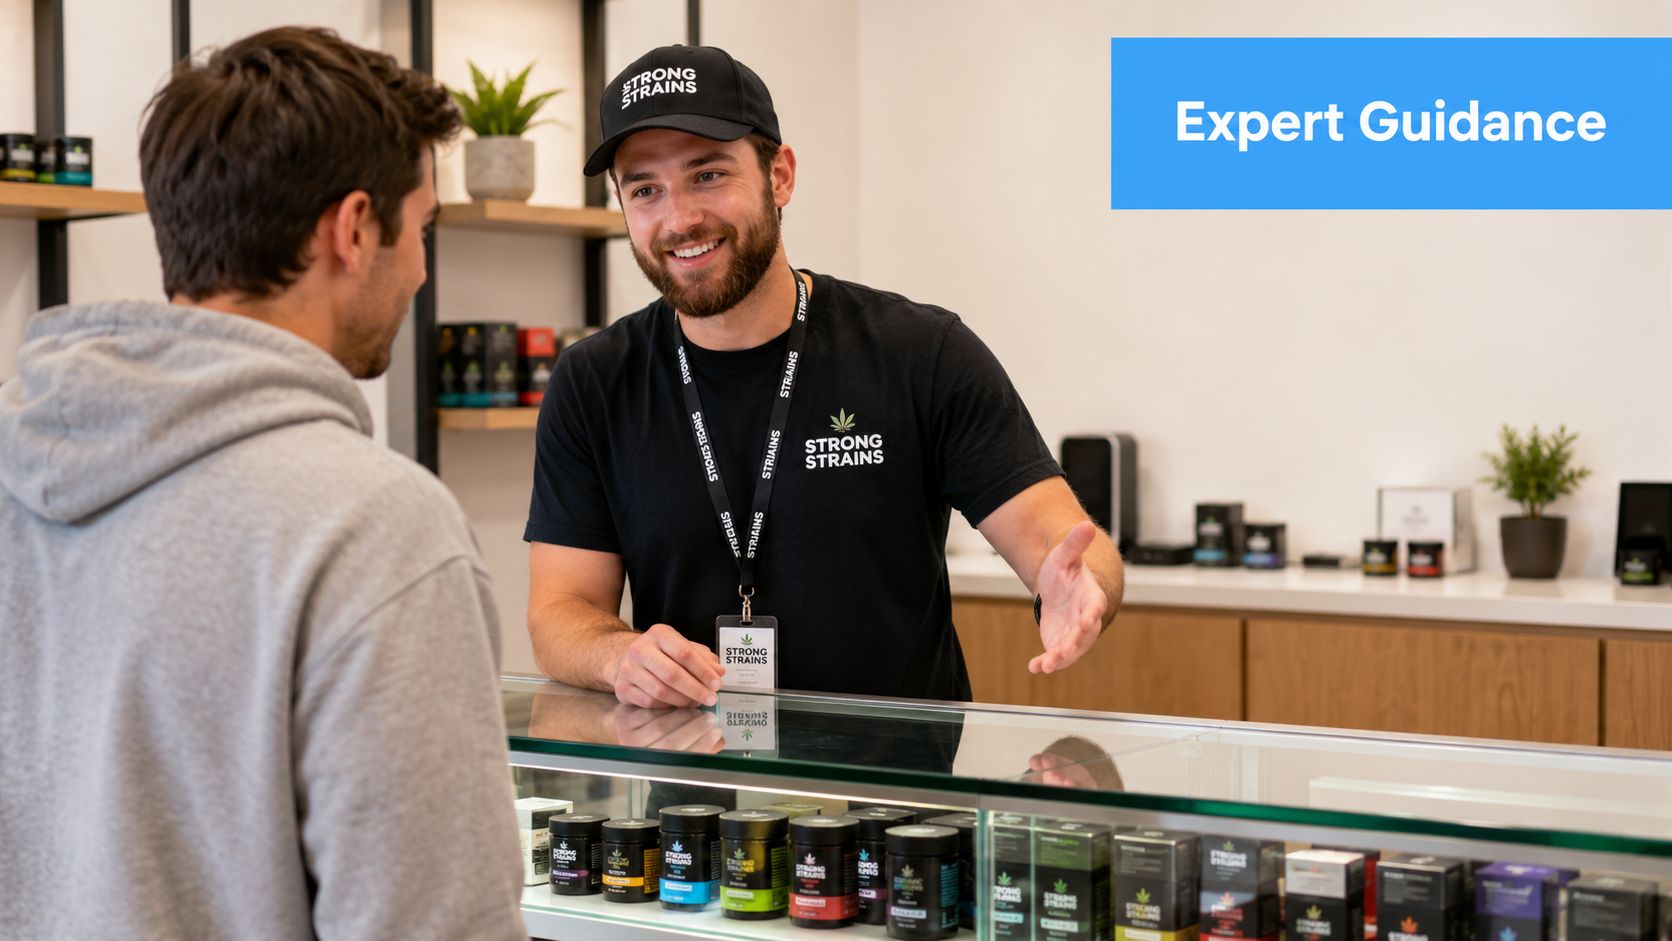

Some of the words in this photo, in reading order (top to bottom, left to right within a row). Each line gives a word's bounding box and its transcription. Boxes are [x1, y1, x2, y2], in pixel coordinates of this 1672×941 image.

[622, 67, 697, 92] STRONG
[621, 81, 697, 110] STRAINS
[805, 433, 883, 454] STRONG
[805, 449, 884, 469] STRAINS
[725, 647, 768, 656] STRONG
[725, 656, 768, 665] STRAINS
